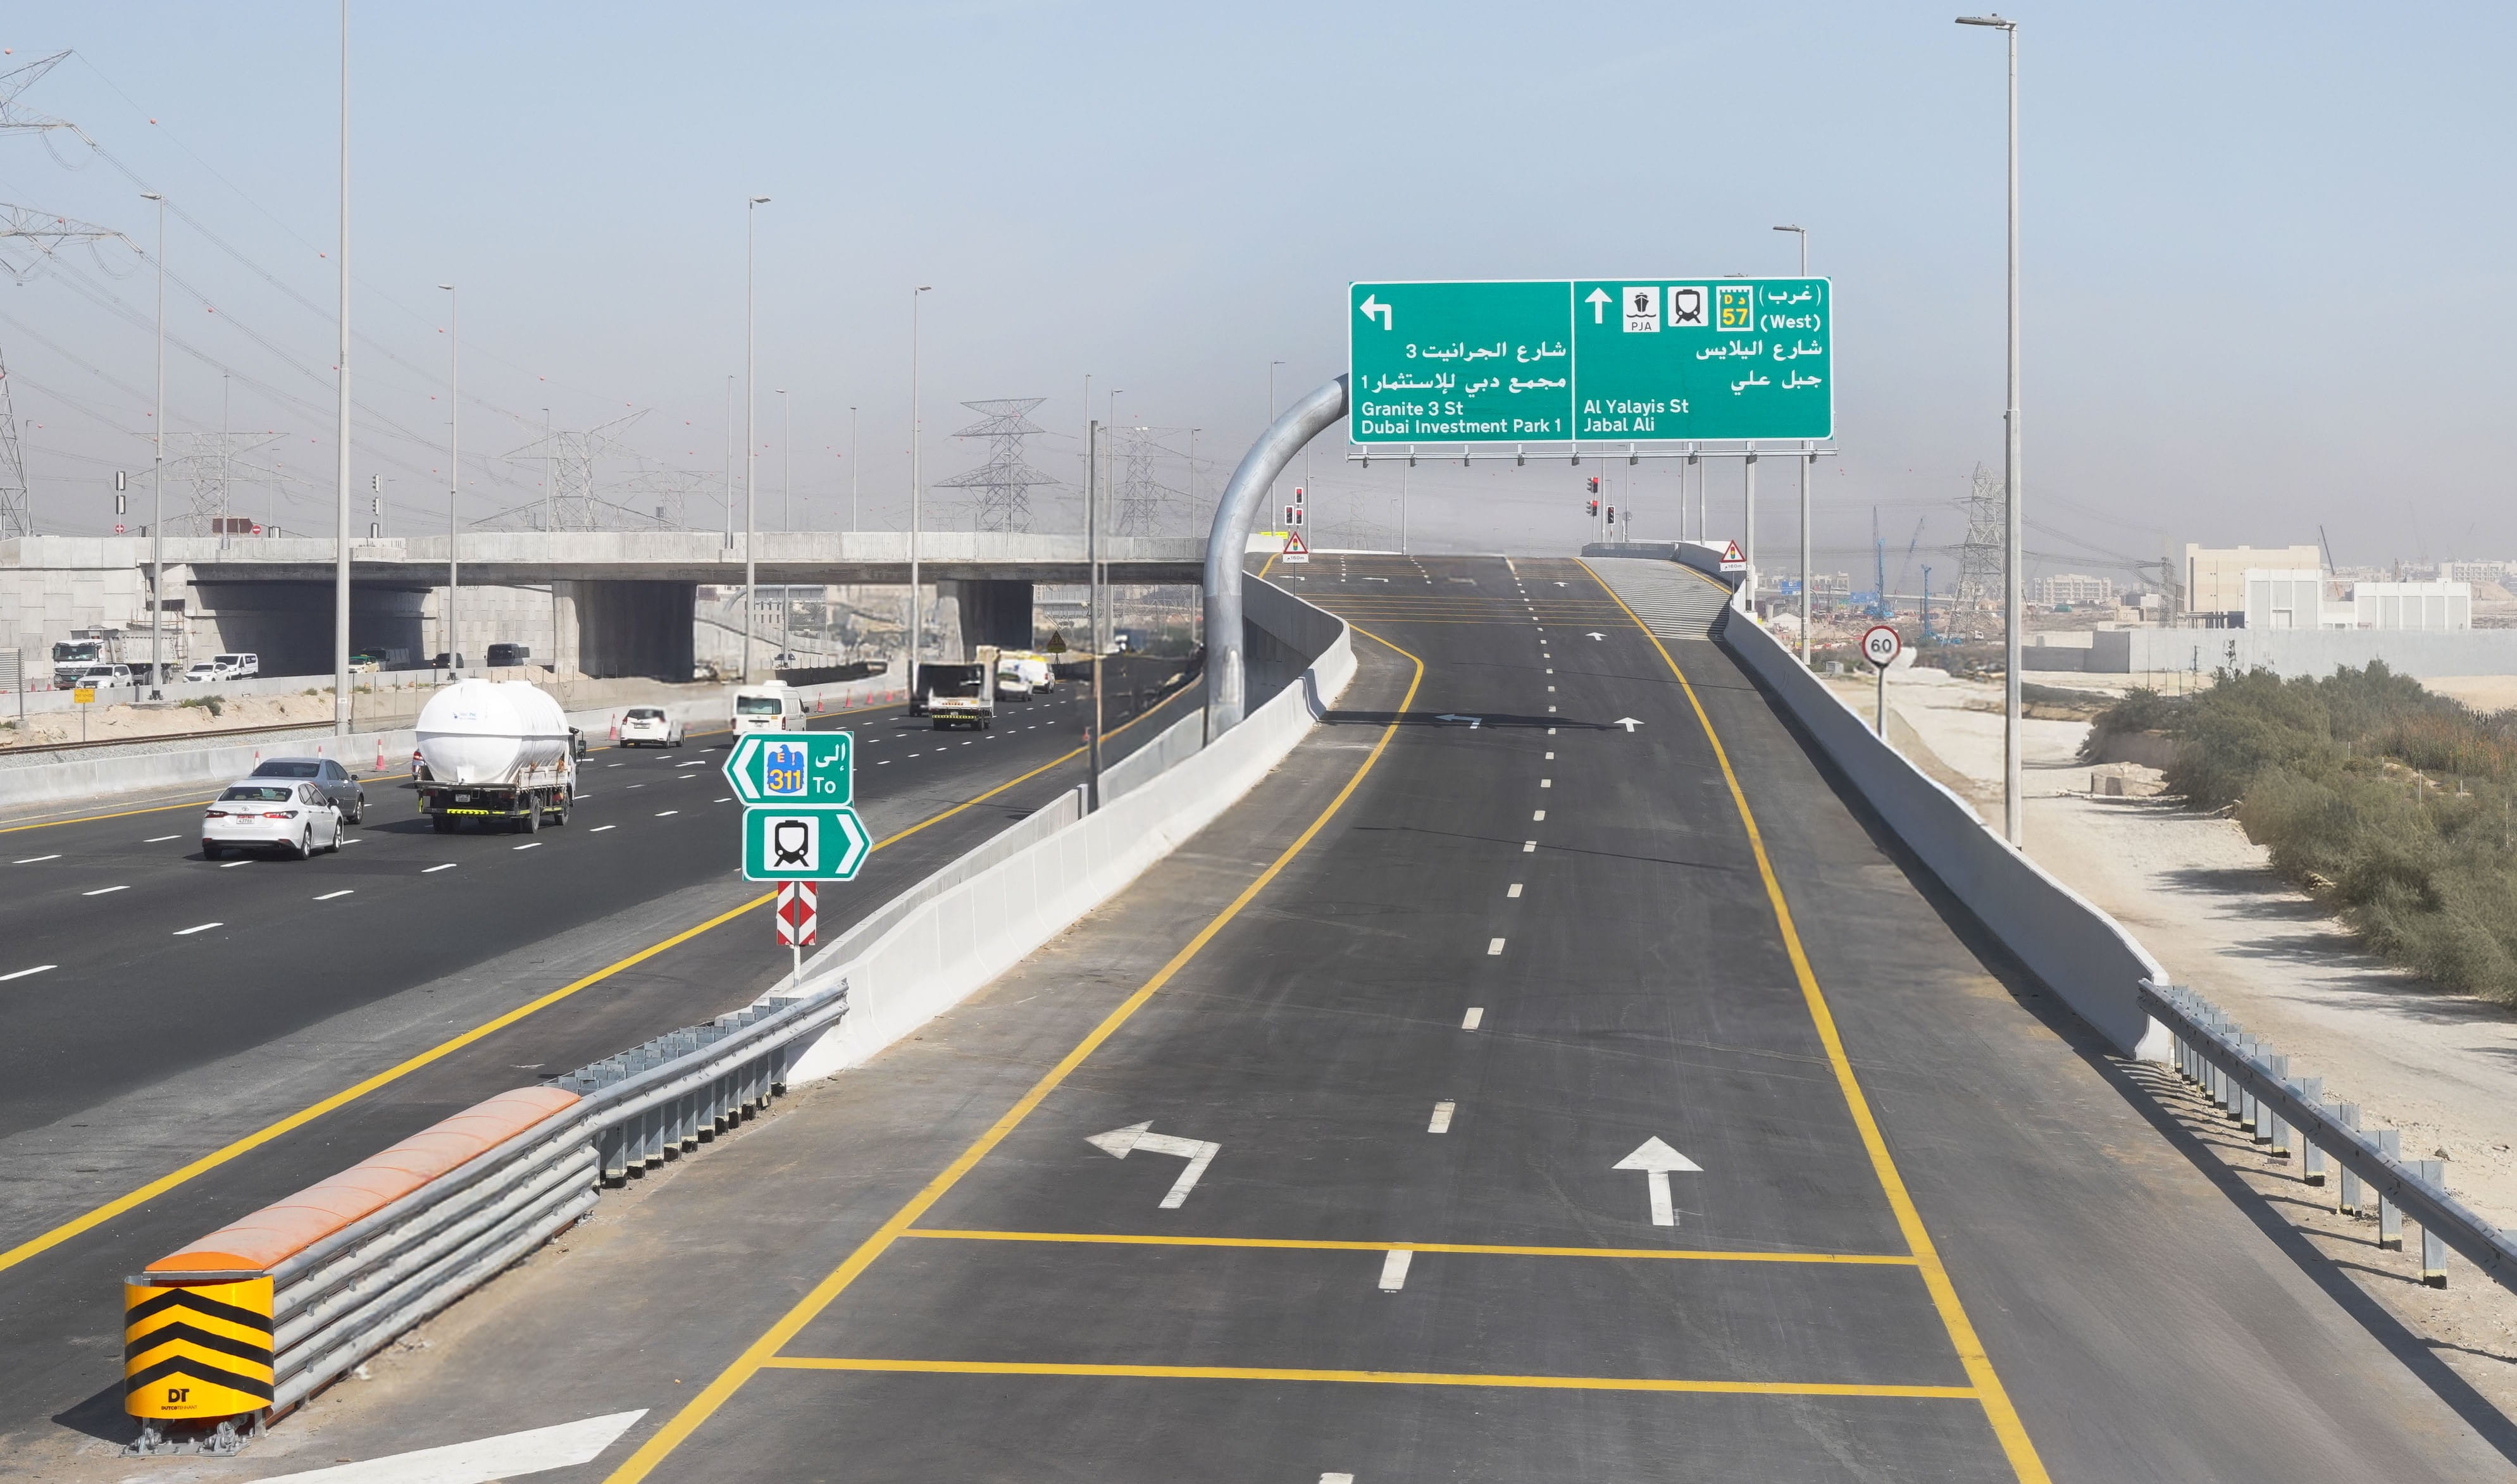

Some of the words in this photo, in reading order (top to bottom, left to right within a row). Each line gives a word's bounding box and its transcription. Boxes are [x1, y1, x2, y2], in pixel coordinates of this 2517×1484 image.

[1724, 295, 1733, 305] D
[1738, 297, 1746, 305] د
[1760, 285, 1822, 306] (غرب)
[1722, 308, 1748, 325] 57
[1760, 314, 1821, 332] (West)
[1631, 321, 1652, 331] PJA
[1406, 343, 1417, 359] 3
[1422, 342, 1507, 362] الجرانيت
[1517, 341, 1566, 362] شارع
[1696, 340, 1763, 360] اليلايس
[1773, 339, 1822, 361] شارع
[1362, 374, 1367, 389] 1
[1372, 373, 1455, 394] للإستثمار
[1465, 377, 1500, 398] دبي
[1508, 377, 1567, 393] مجمع
[1731, 370, 1771, 395] علي
[1781, 369, 1822, 389] جبل
[1362, 401, 1424, 416] Granite
[1428, 401, 1439, 416] 3
[1445, 401, 1464, 416] St
[1584, 400, 1601, 414] Al
[1606, 399, 1664, 416] Yalayis
[1670, 399, 1689, 413] St
[1362, 420, 1409, 434] Dubai
[1415, 419, 1508, 433] Investment
[1513, 418, 1550, 433] Park
[1555, 418, 1560, 432] 1
[1584, 417, 1629, 432] Jabal
[1633, 417, 1655, 431] Ali
[1871, 639, 1891, 652] 60
[777, 753, 785, 763] E
[815, 743, 846, 771] إلى
[769, 769, 801, 791] 311
[812, 777, 836, 794] To
[168, 1388, 190, 1403] DT
